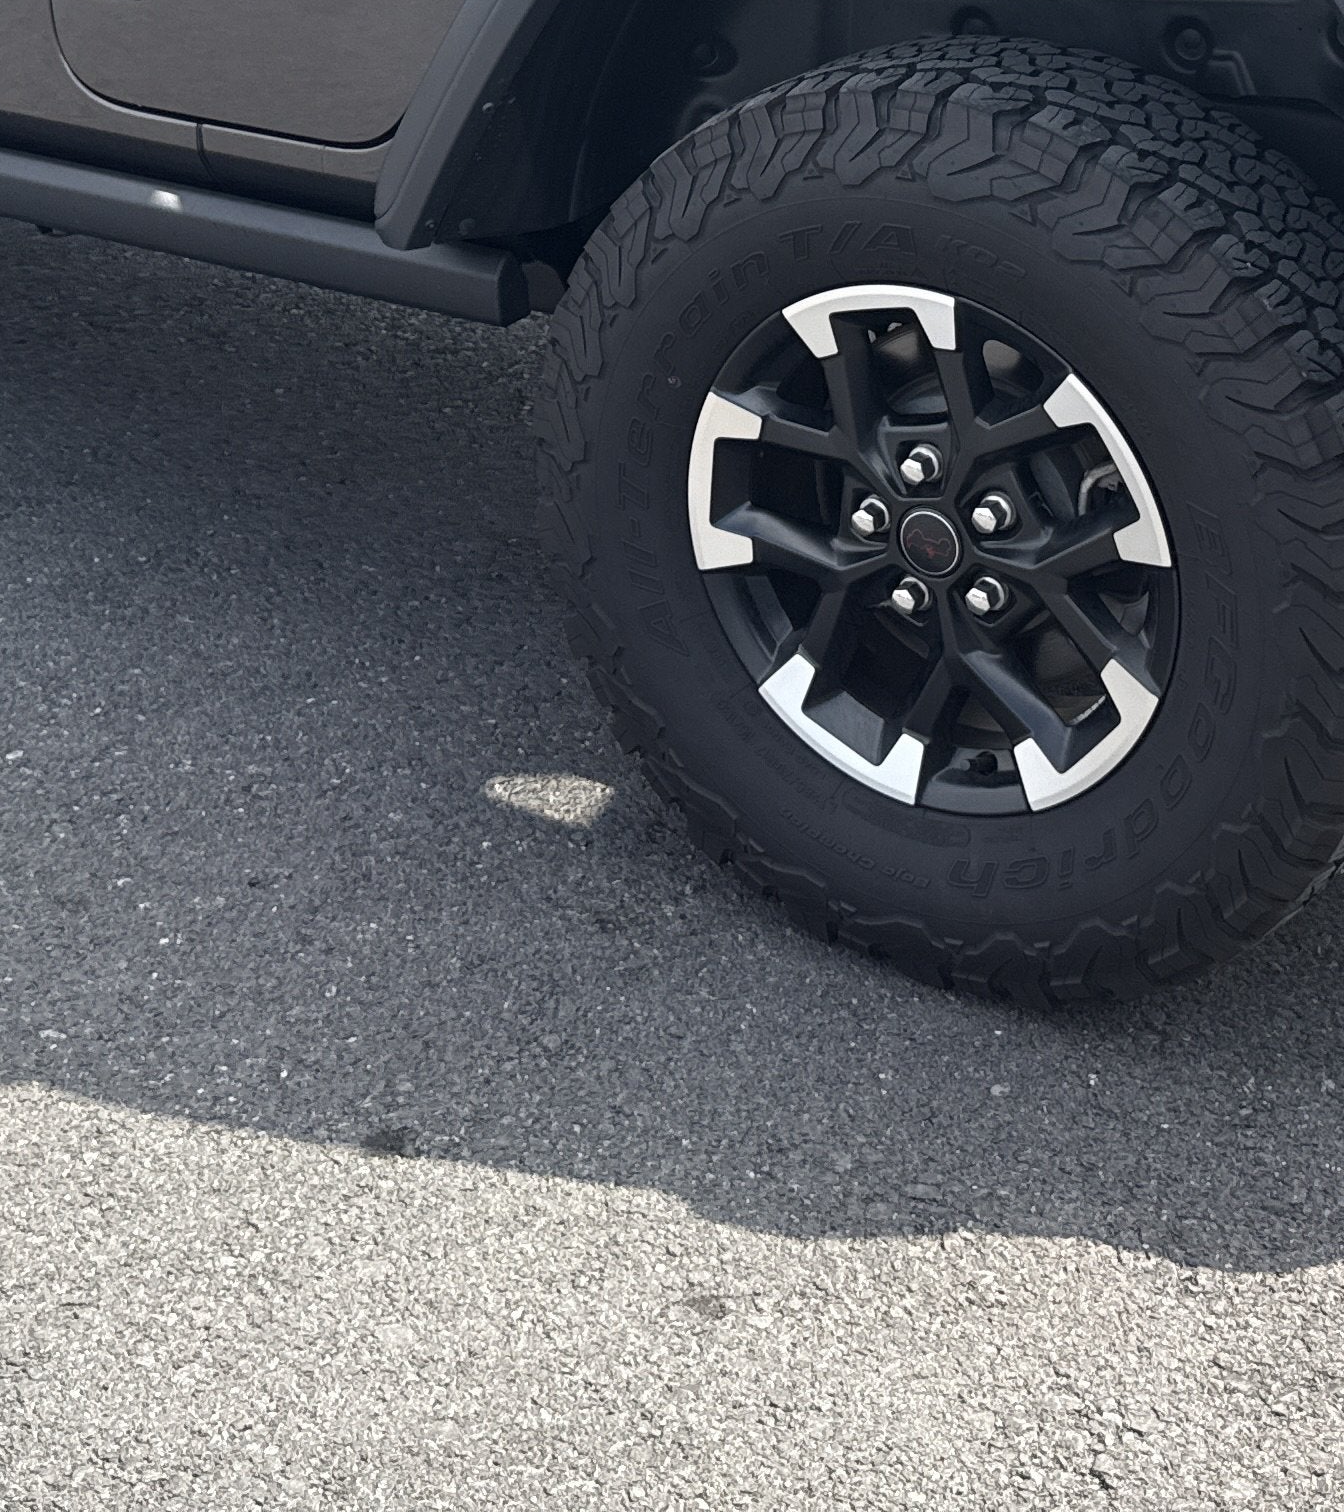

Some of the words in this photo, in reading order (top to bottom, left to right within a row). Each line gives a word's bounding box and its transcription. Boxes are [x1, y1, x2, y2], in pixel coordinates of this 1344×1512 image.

[619, 250, 771, 657] All-Terrain
[780, 221, 918, 263] T/A
[946, 500, 1238, 898] BFGoodrich
